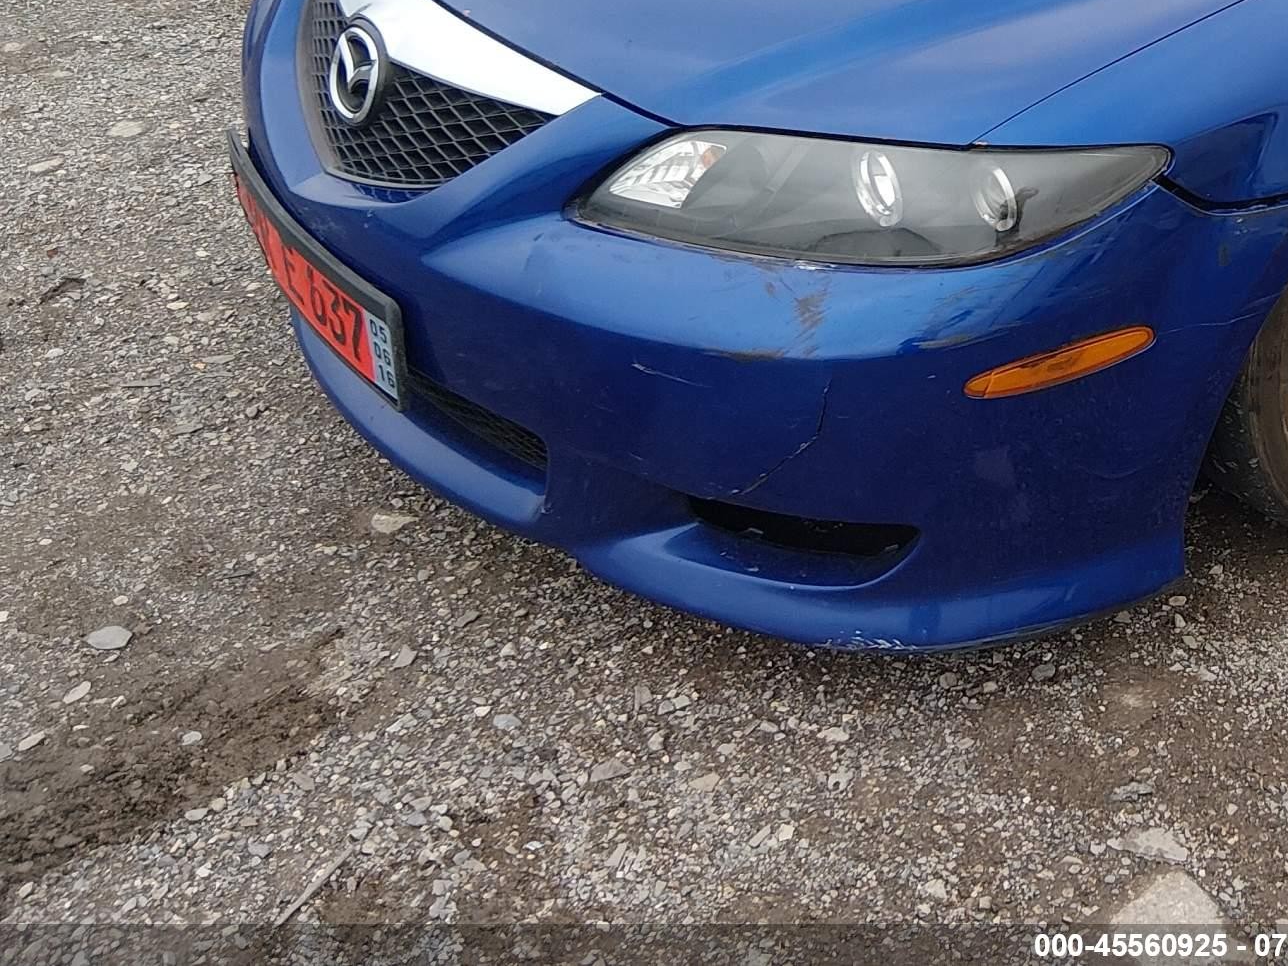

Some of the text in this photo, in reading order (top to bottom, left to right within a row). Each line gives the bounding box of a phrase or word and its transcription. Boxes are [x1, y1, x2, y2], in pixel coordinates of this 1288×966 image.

[306, 264, 363, 363] 637
[369, 318, 388, 344] 05
[373, 341, 392, 367] 06
[378, 364, 396, 389] 16
